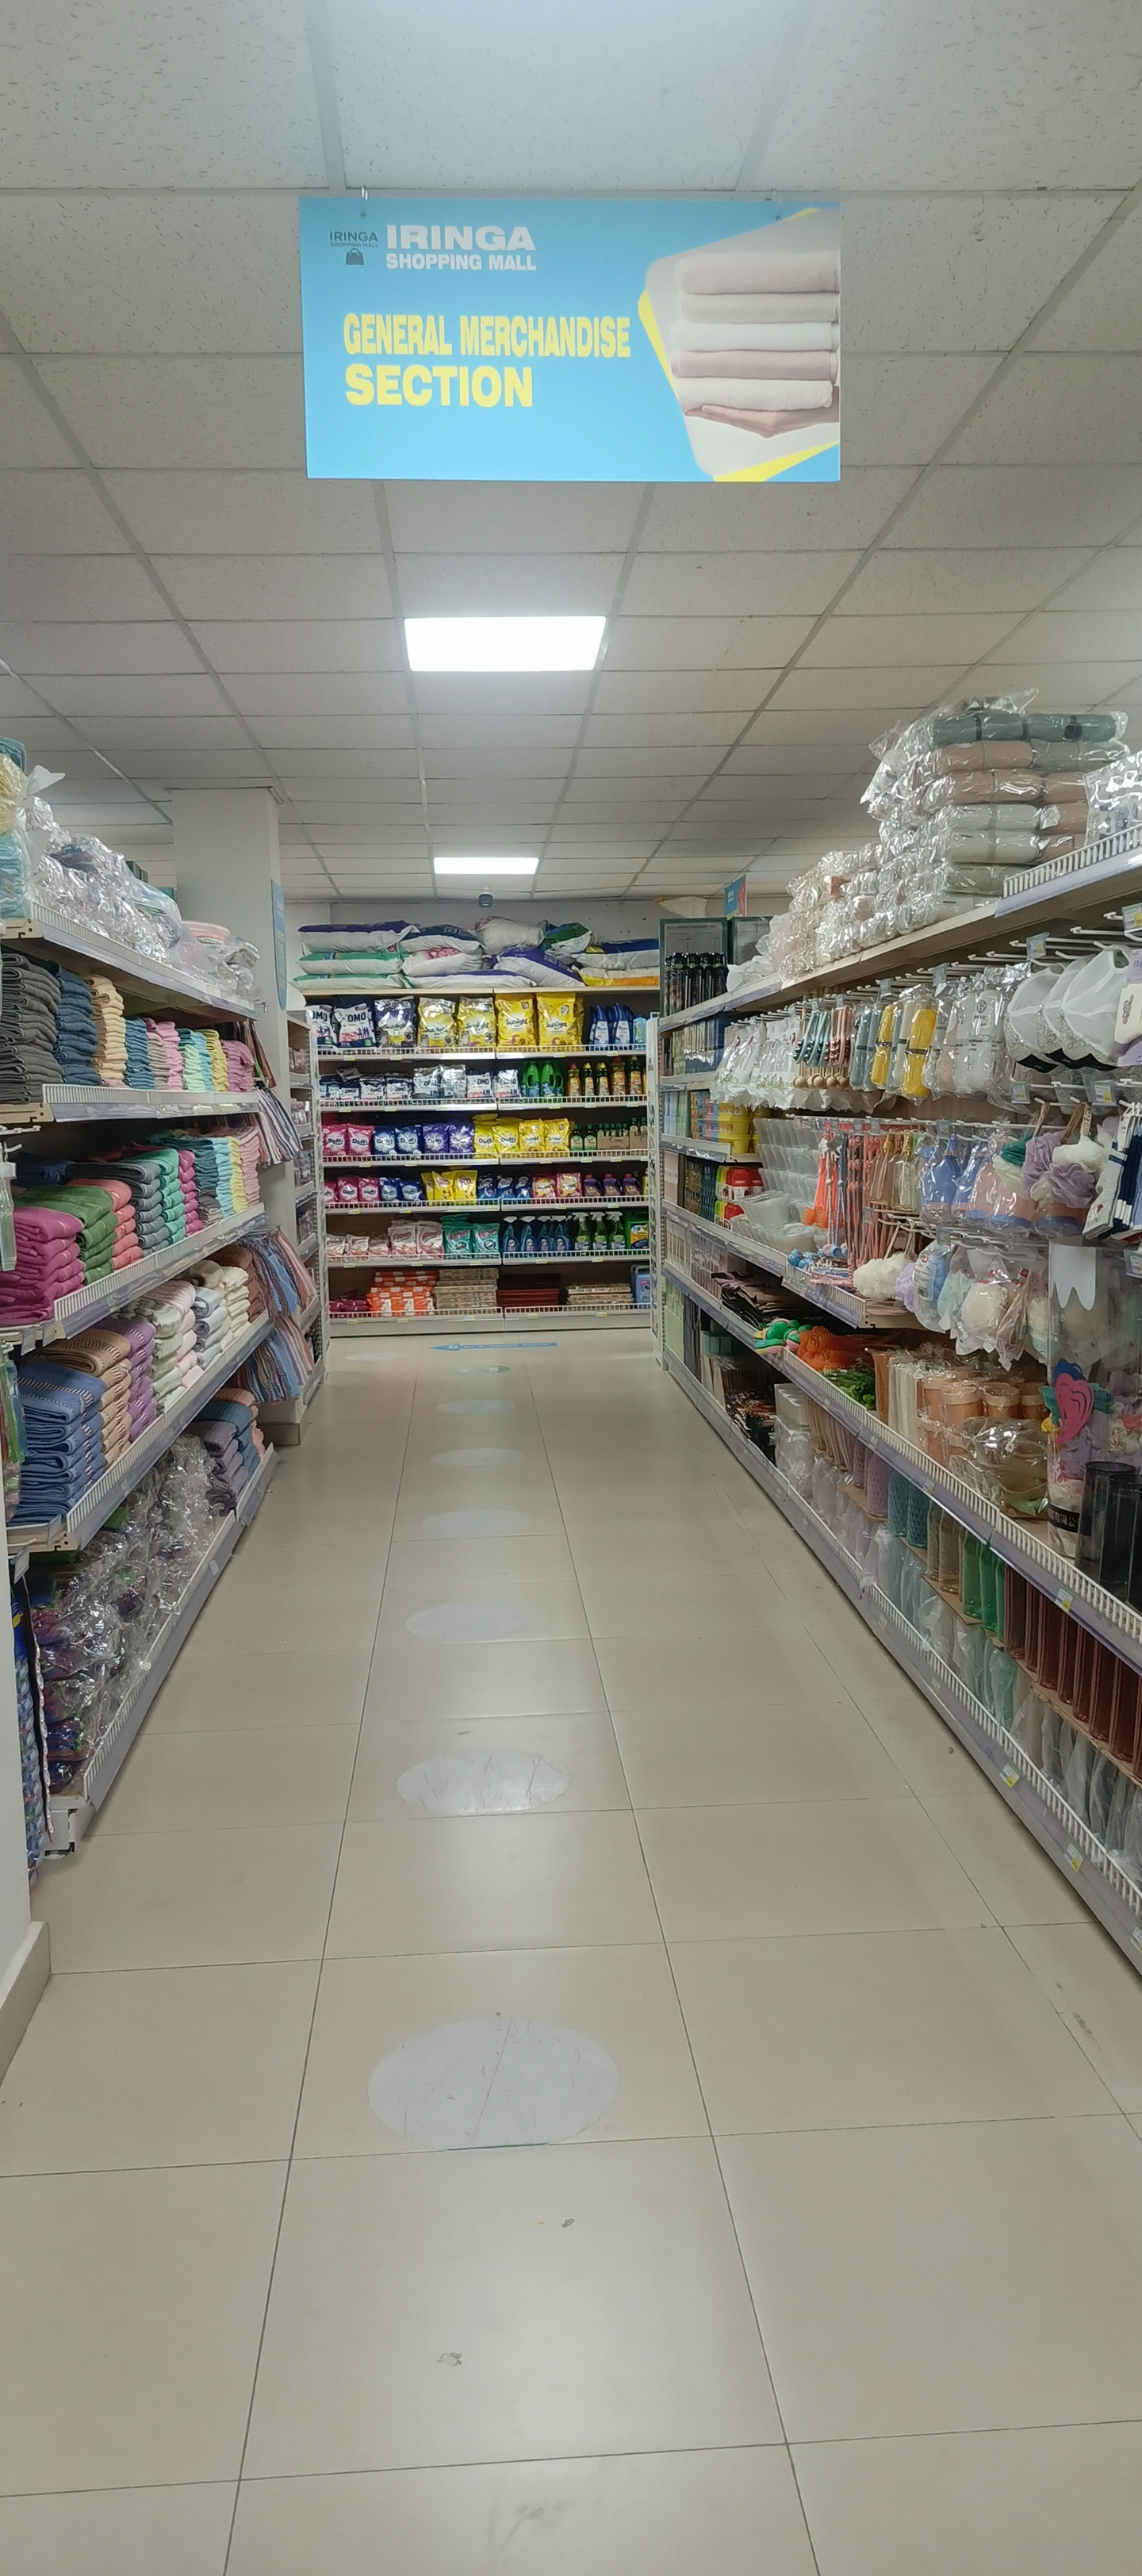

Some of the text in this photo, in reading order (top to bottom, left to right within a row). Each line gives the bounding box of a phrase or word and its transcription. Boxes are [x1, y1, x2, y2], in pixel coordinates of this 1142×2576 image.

[330, 231, 379, 242] IRINGA
[387, 224, 536, 251] IRINGA
[386, 253, 537, 271] SHOPPING MALL
[343, 312, 631, 358] GENERAL MERCHANDISE
[345, 363, 533, 408] SECTION
[347, 1012, 366, 1022] OMO
[505, 1018, 528, 1026] Sunlight
[546, 1020, 568, 1029] Sunlight
[1048, 1508, 1079, 1528] 有限公
